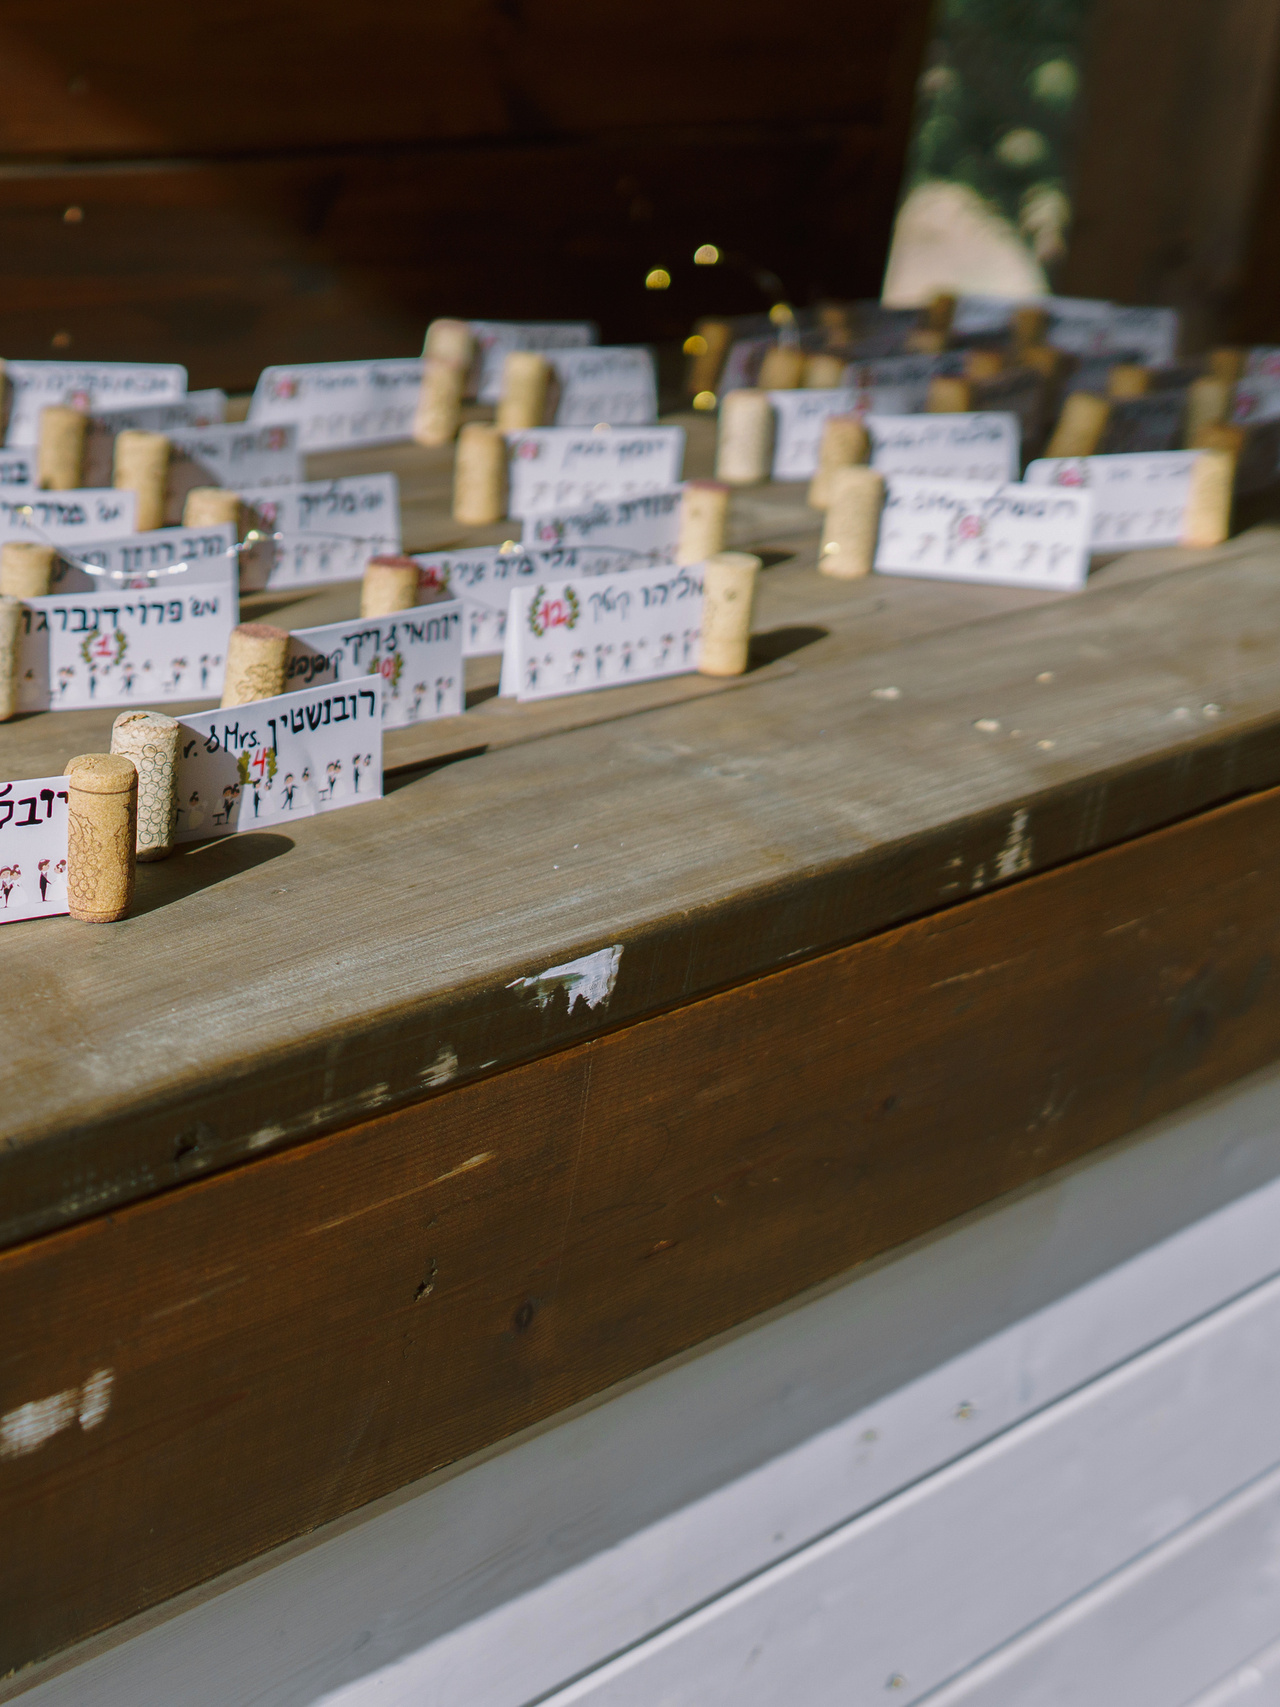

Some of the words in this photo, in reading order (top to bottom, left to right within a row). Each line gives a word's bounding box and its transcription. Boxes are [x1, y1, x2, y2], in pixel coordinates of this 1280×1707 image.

[641, 568, 705, 608] אליהו
[402, 613, 460, 644] יוחאי
[538, 598, 570, 629] 12
[251, 747, 267, 777] 4
